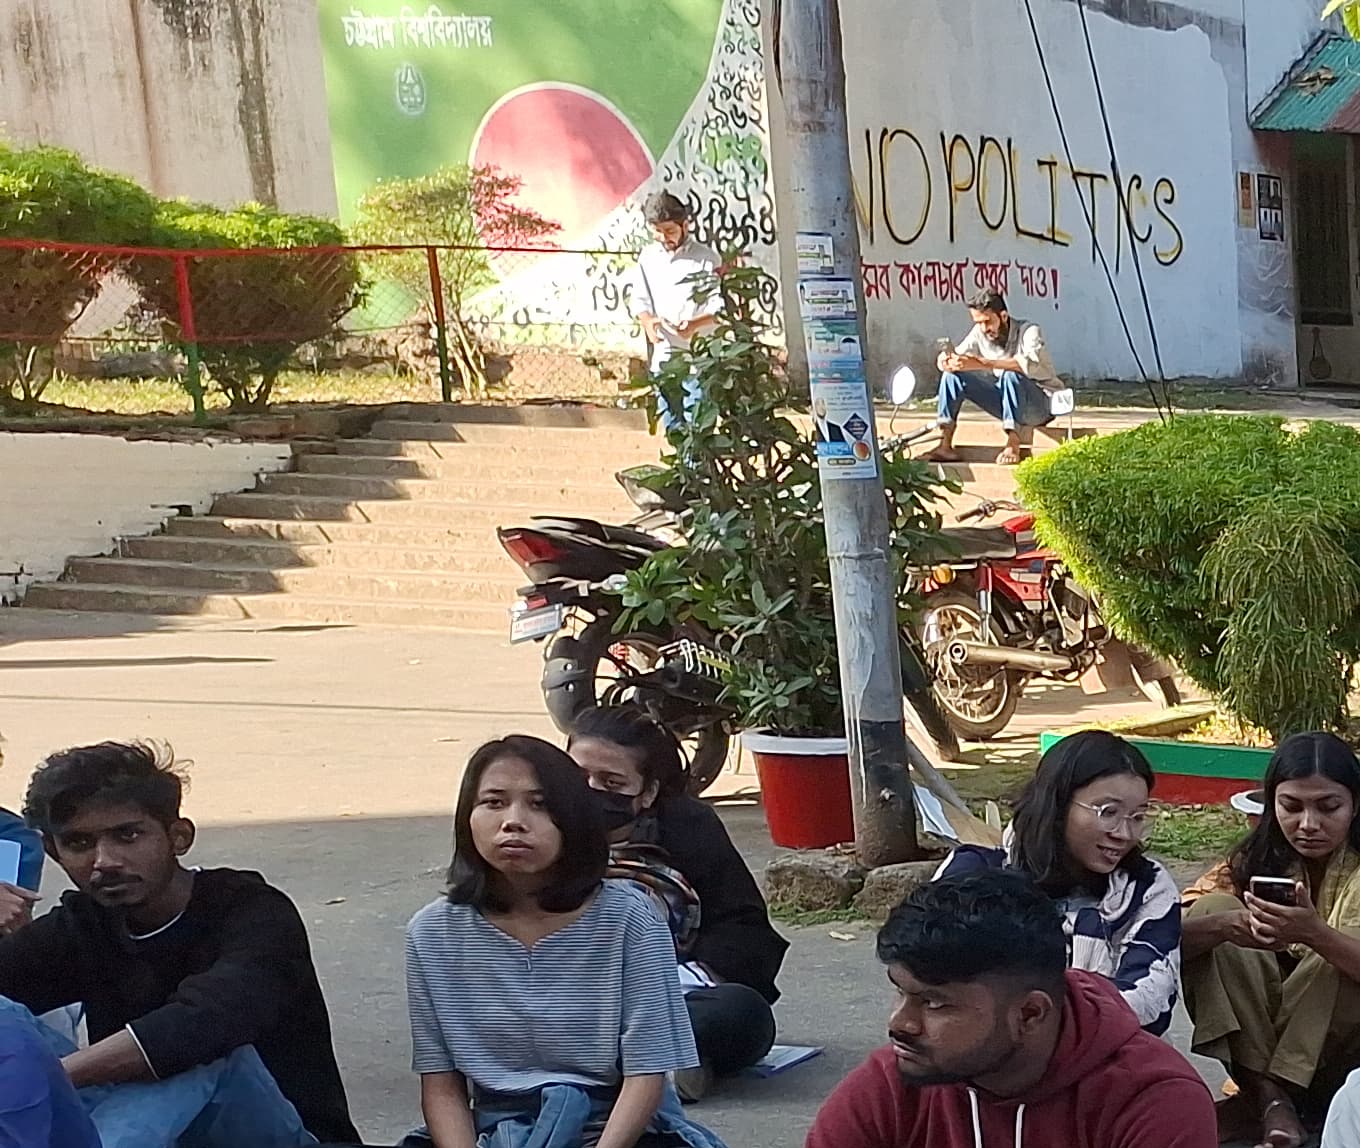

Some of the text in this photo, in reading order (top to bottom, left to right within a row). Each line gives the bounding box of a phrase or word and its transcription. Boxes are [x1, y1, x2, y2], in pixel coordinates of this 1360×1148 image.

[400, 5, 493, 48] বিশ্ববিদ্যালয়
[940, 131, 1184, 275] POLITICS
[894, 257, 969, 303] কালচার
